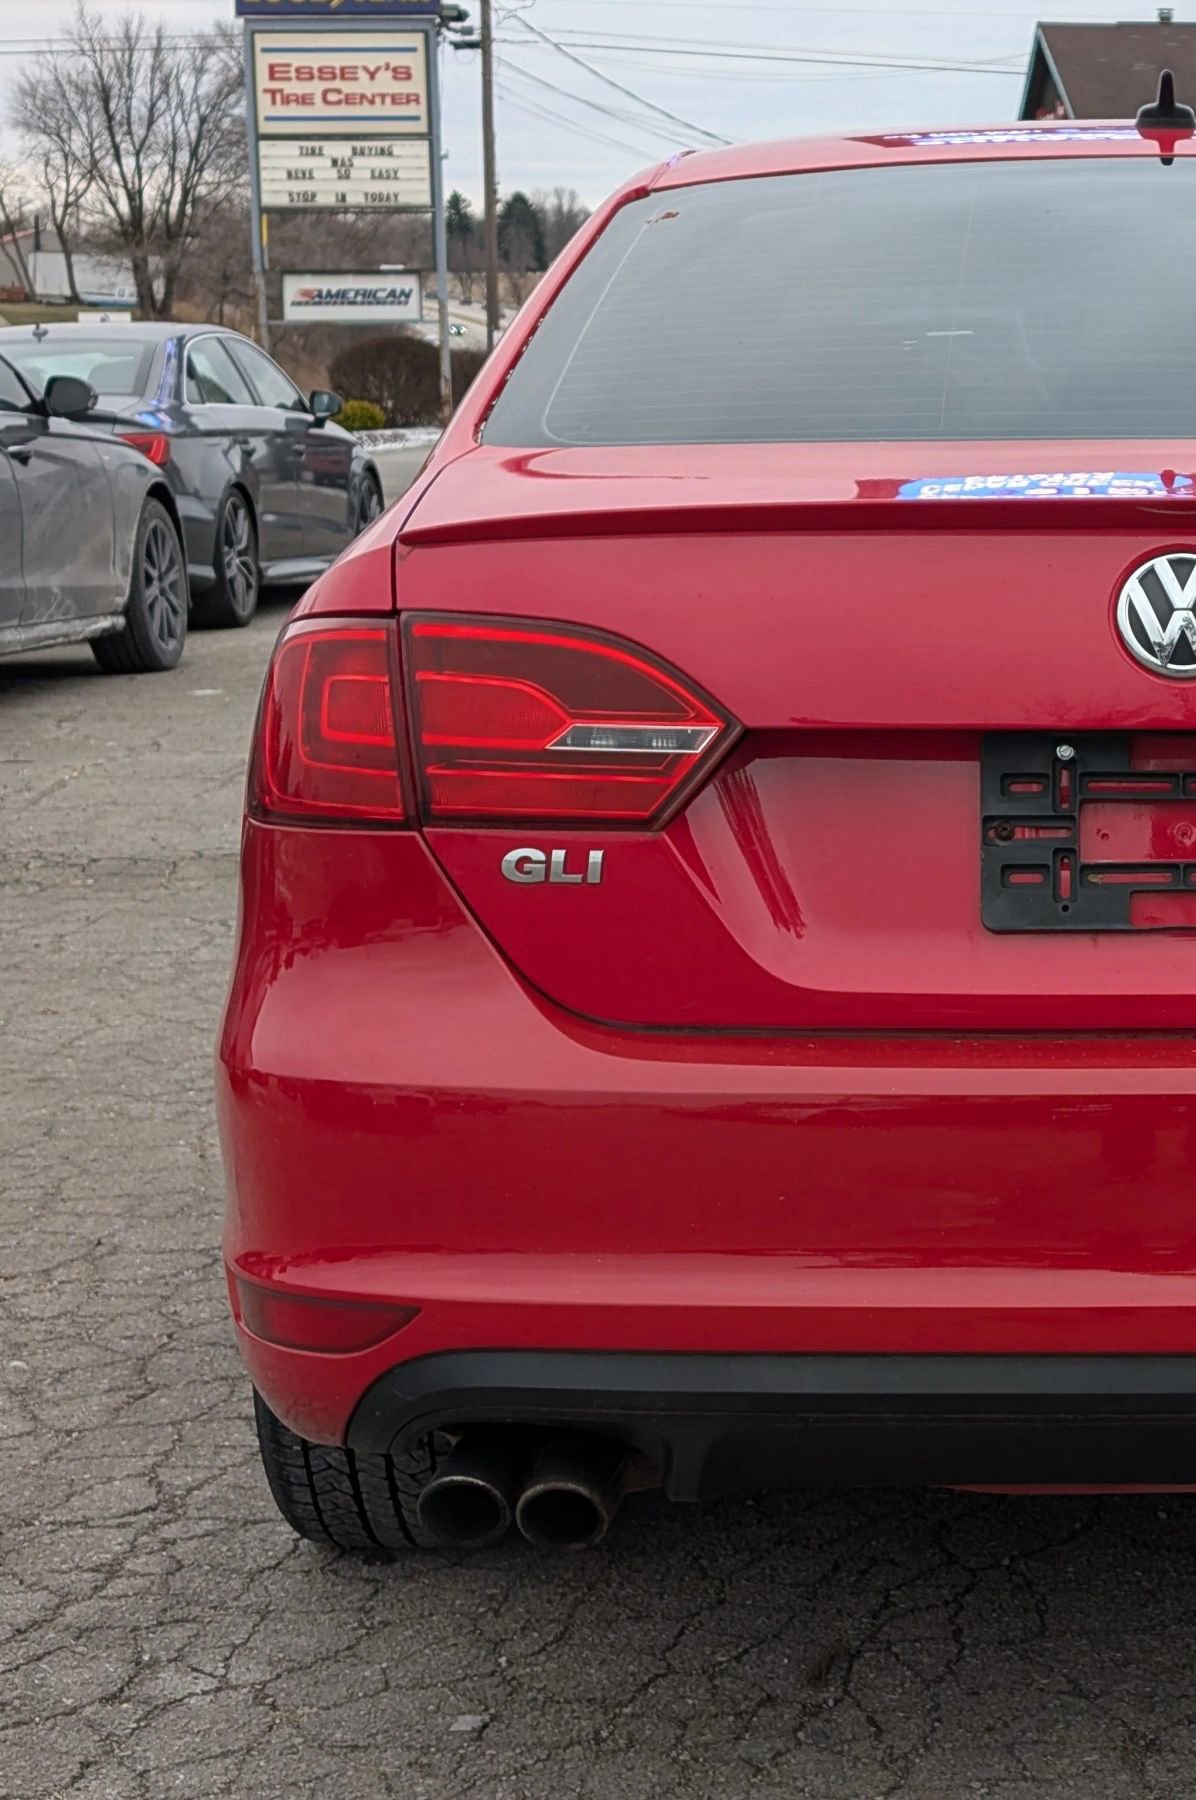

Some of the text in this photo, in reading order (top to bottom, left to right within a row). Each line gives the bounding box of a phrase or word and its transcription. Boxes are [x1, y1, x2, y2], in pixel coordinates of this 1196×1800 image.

[268, 62, 412, 81] ESSEY'S
[263, 88, 420, 106] TIRE CENTER
[299, 145, 394, 156] TIRE BUYING
[331, 156, 354, 168] WAS
[337, 168, 351, 180] SO
[370, 168, 399, 180] EASY
[288, 191, 399, 203] STOP IN TODAY
[311, 287, 414, 300] AMERICAN
[501, 847, 604, 883] GLI
